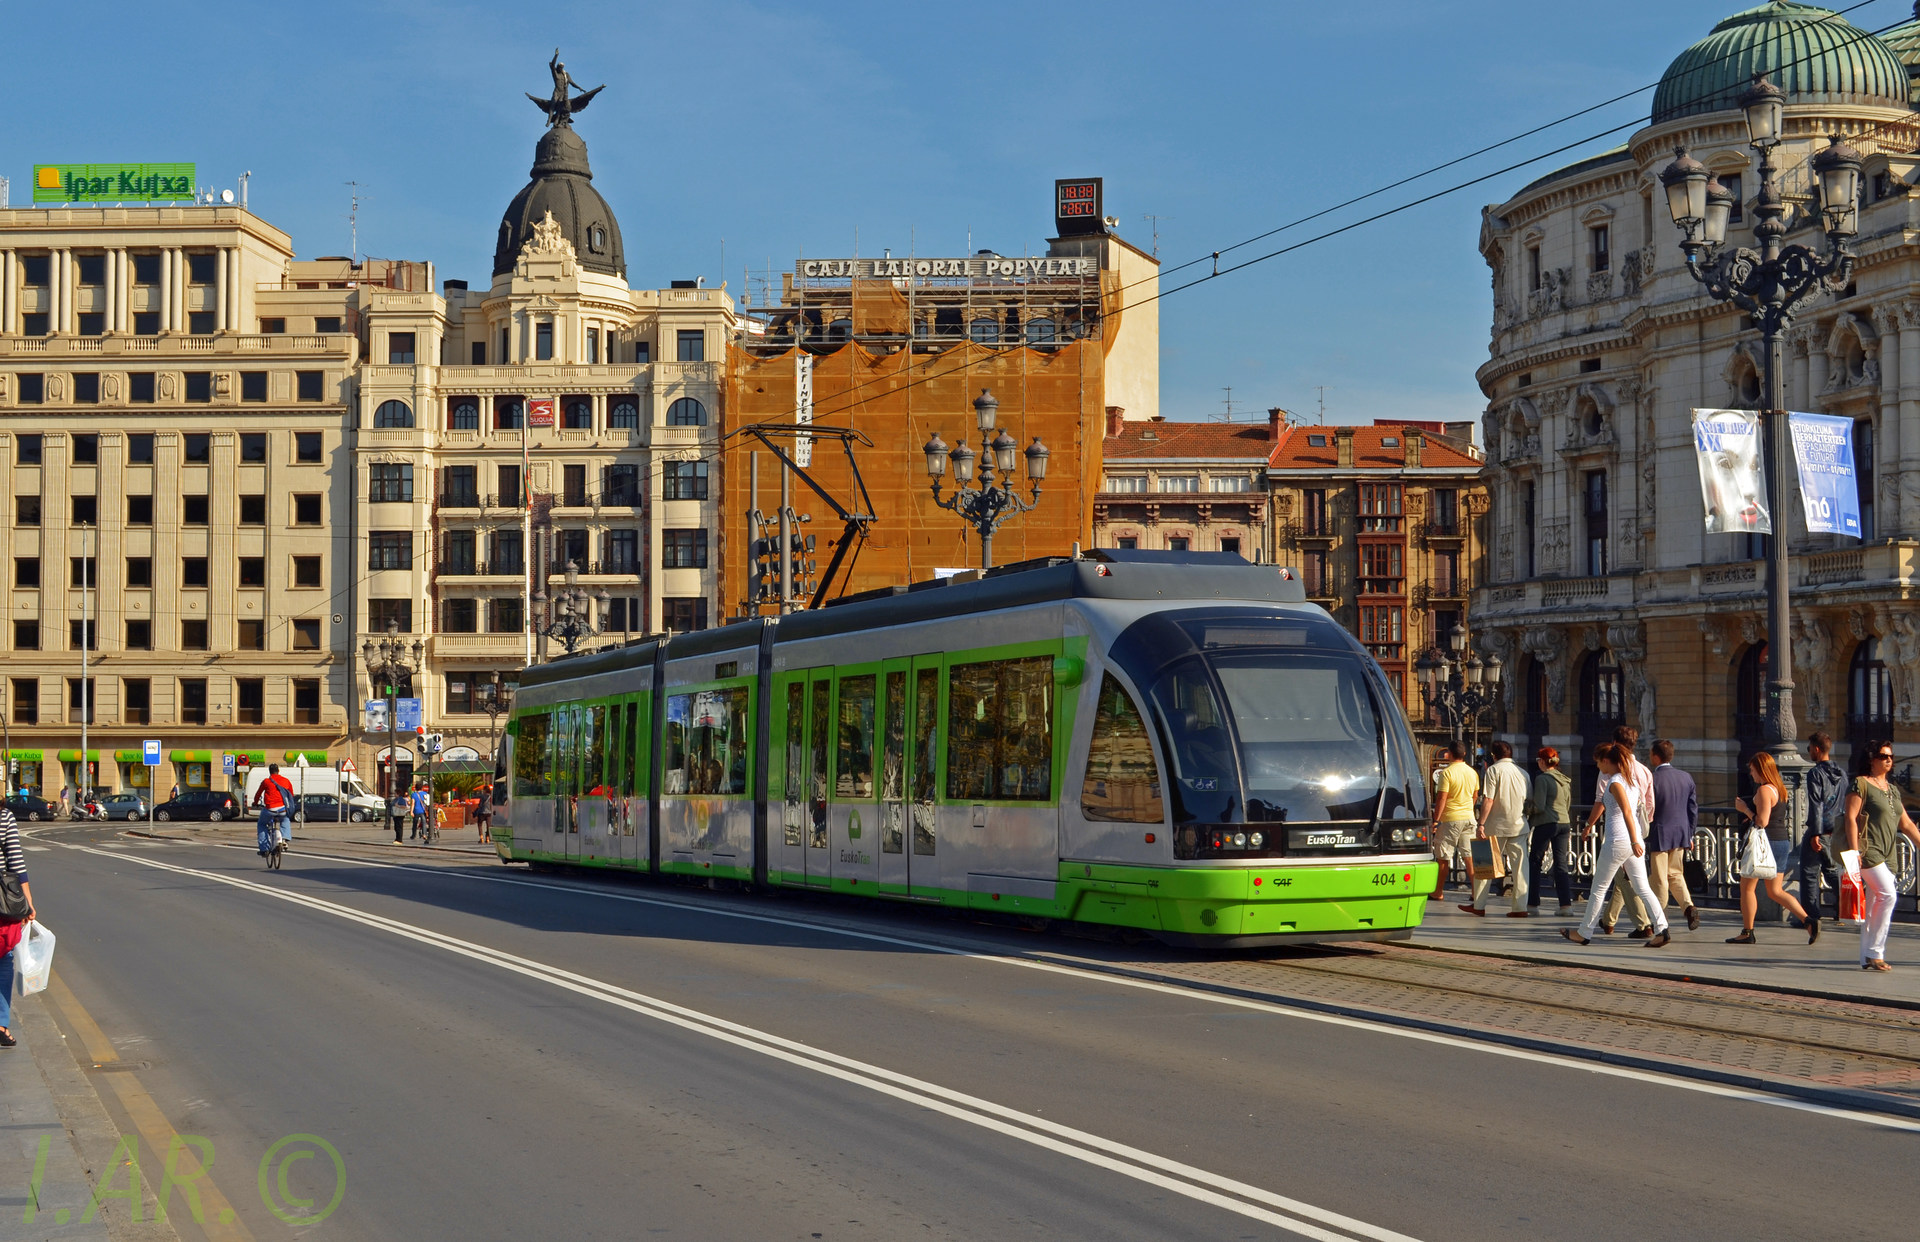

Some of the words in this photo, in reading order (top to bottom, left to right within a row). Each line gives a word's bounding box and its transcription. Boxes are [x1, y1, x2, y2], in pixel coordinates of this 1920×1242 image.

[65, 171, 115, 201] Ipar
[119, 171, 189, 198] Kutxa
[804, 260, 860, 277] CAJA
[873, 260, 975, 277] LABORAL
[1797, 441, 1836, 454] REPASANDO
[1809, 451, 1835, 463] FUTURO
[1306, 834, 1356, 845] EuskoTran
[1273, 878, 1293, 887] CAF
[1371, 873, 1396, 886] 404
